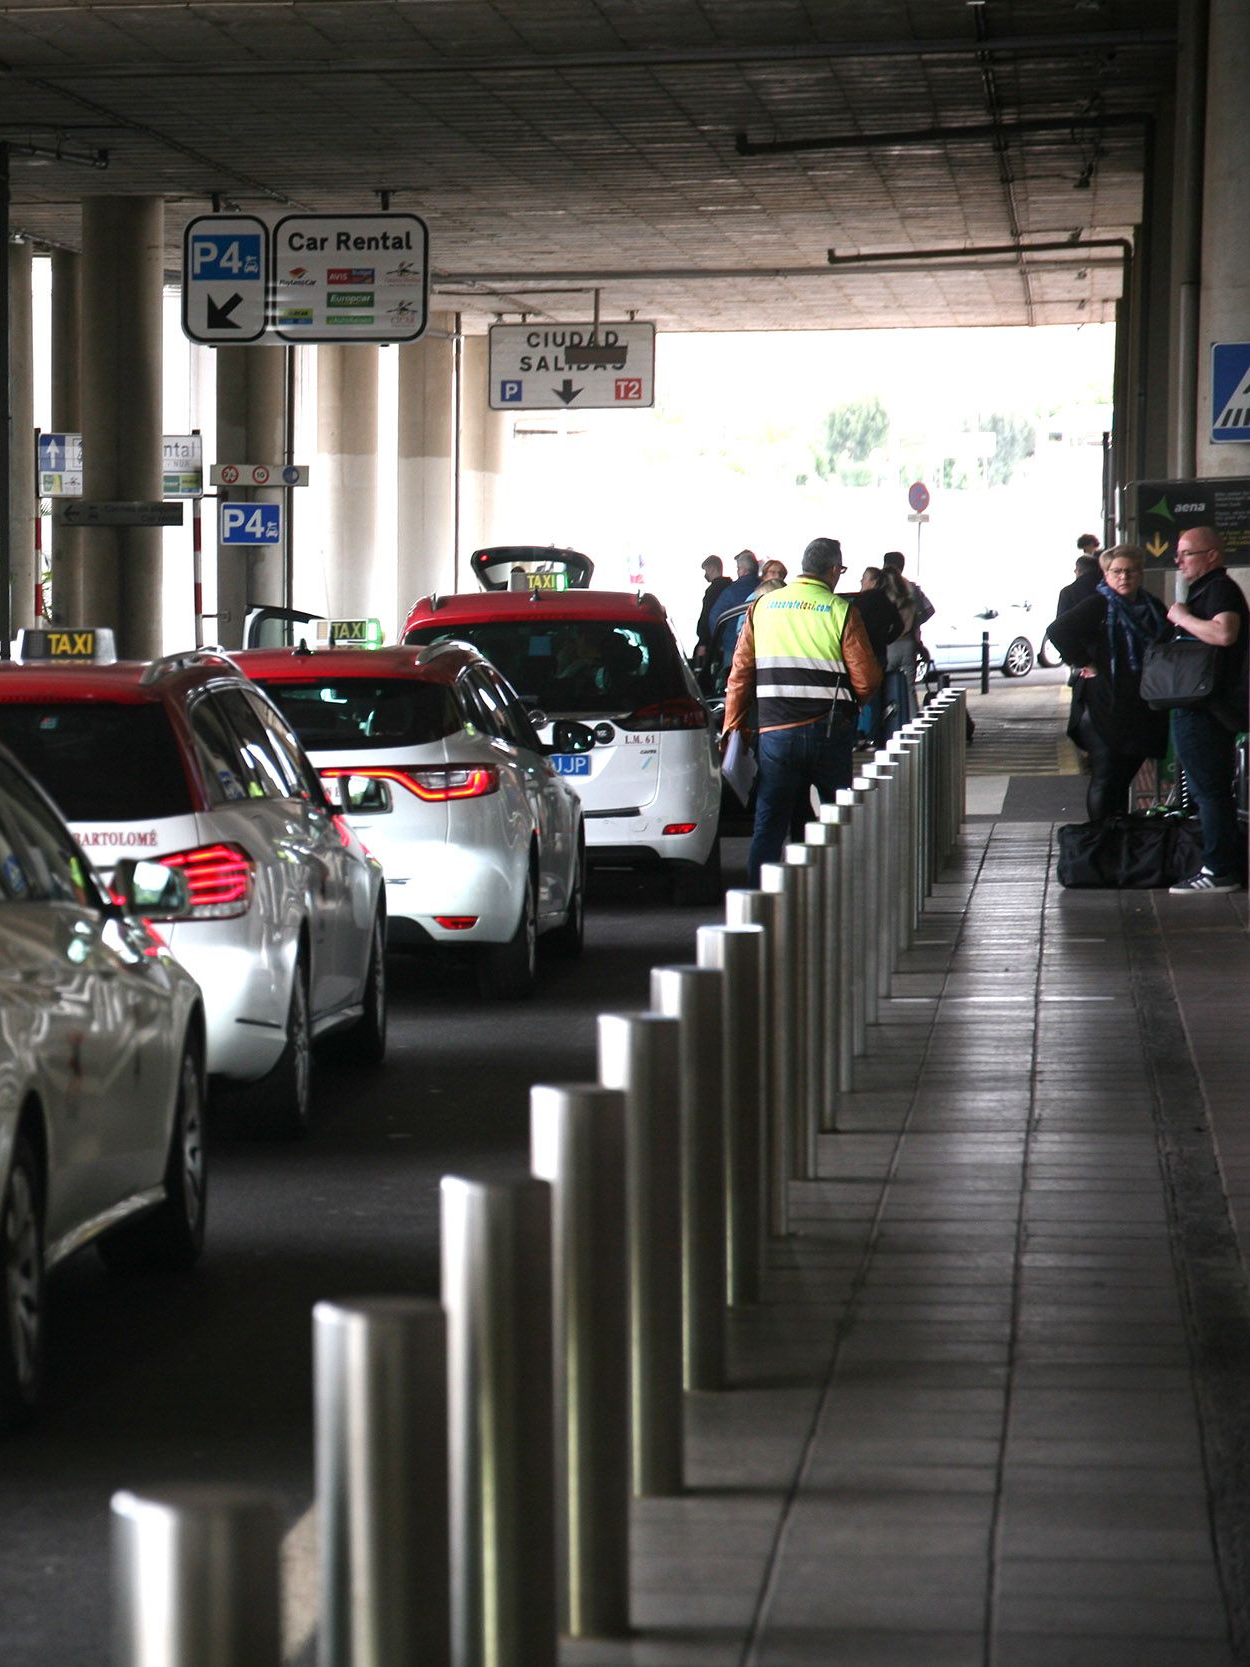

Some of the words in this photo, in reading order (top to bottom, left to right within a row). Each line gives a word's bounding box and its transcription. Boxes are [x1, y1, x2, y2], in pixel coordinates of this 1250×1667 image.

[288, 232, 328, 252] Car
[337, 231, 413, 251] Rental
[193, 241, 242, 275] P4
[330, 294, 371, 304] Europcar
[527, 331, 619, 348] CIUDAD
[505, 383, 518, 399] P
[617, 381, 640, 399] T2
[163, 441, 195, 457] ntal
[1174, 502, 1206, 513] aena
[224, 508, 265, 538] P4
[526, 574, 555, 588] TAXI
[332, 622, 366, 639] TAXI
[47, 633, 94, 655] TAXI
